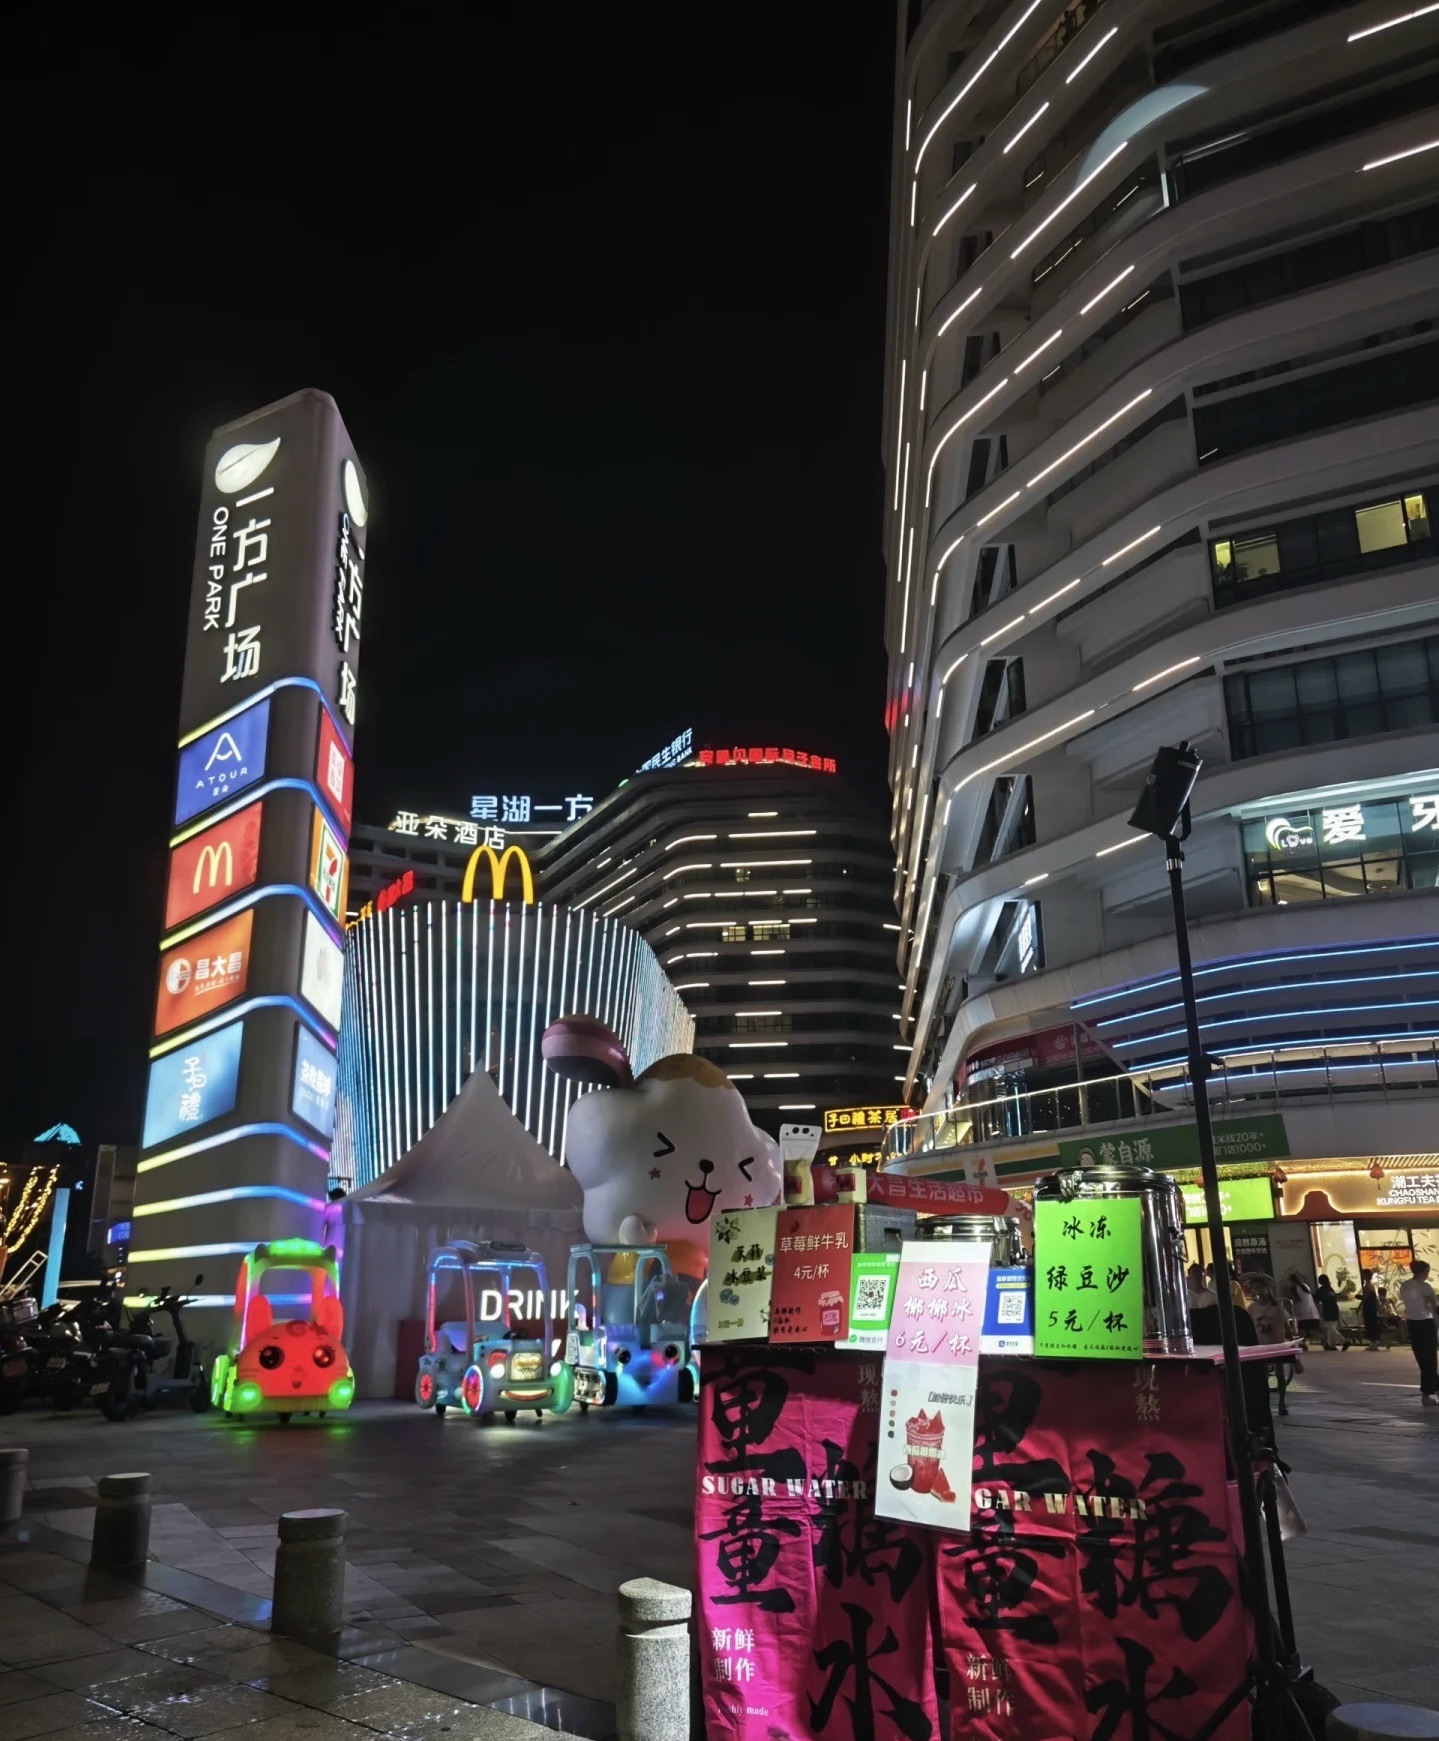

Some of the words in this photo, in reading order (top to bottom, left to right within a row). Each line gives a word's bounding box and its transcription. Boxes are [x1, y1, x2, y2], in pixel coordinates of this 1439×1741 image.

[209, 506, 230, 558] ONE
[203, 564, 224, 632] PARK
[220, 487, 275, 684] 一方广场
[195, 766, 248, 789] ATOUR
[470, 794, 594, 823] 星湖一方
[395, 810, 505, 850] 亚朵酒店
[195, 951, 243, 981] 昌大昌
[1099, 1137, 1155, 1165] 蒙自源
[1417, 1195, 1436, 1204] TEA
[1062, 1215, 1112, 1240] 冰冻
[779, 1232, 849, 1253] 草莓鲜牛乳
[793, 1264, 830, 1280] 4元/杯
[918, 1266, 968, 1293] 西瓜
[1046, 1265, 1130, 1294] 绿豆沙
[480, 1289, 580, 1321] DRINK
[1047, 1309, 1129, 1333] 5元/杯
[895, 1329, 973, 1356] 6元/杯
[702, 1475, 777, 1497] SUGAR
[786, 1478, 869, 1500] WATER
[1044, 1492, 1149, 1520] WATER
[711, 1627, 755, 1653] 新鲜
[714, 1656, 756, 1682] 制作
[747, 1706, 769, 1717] made
